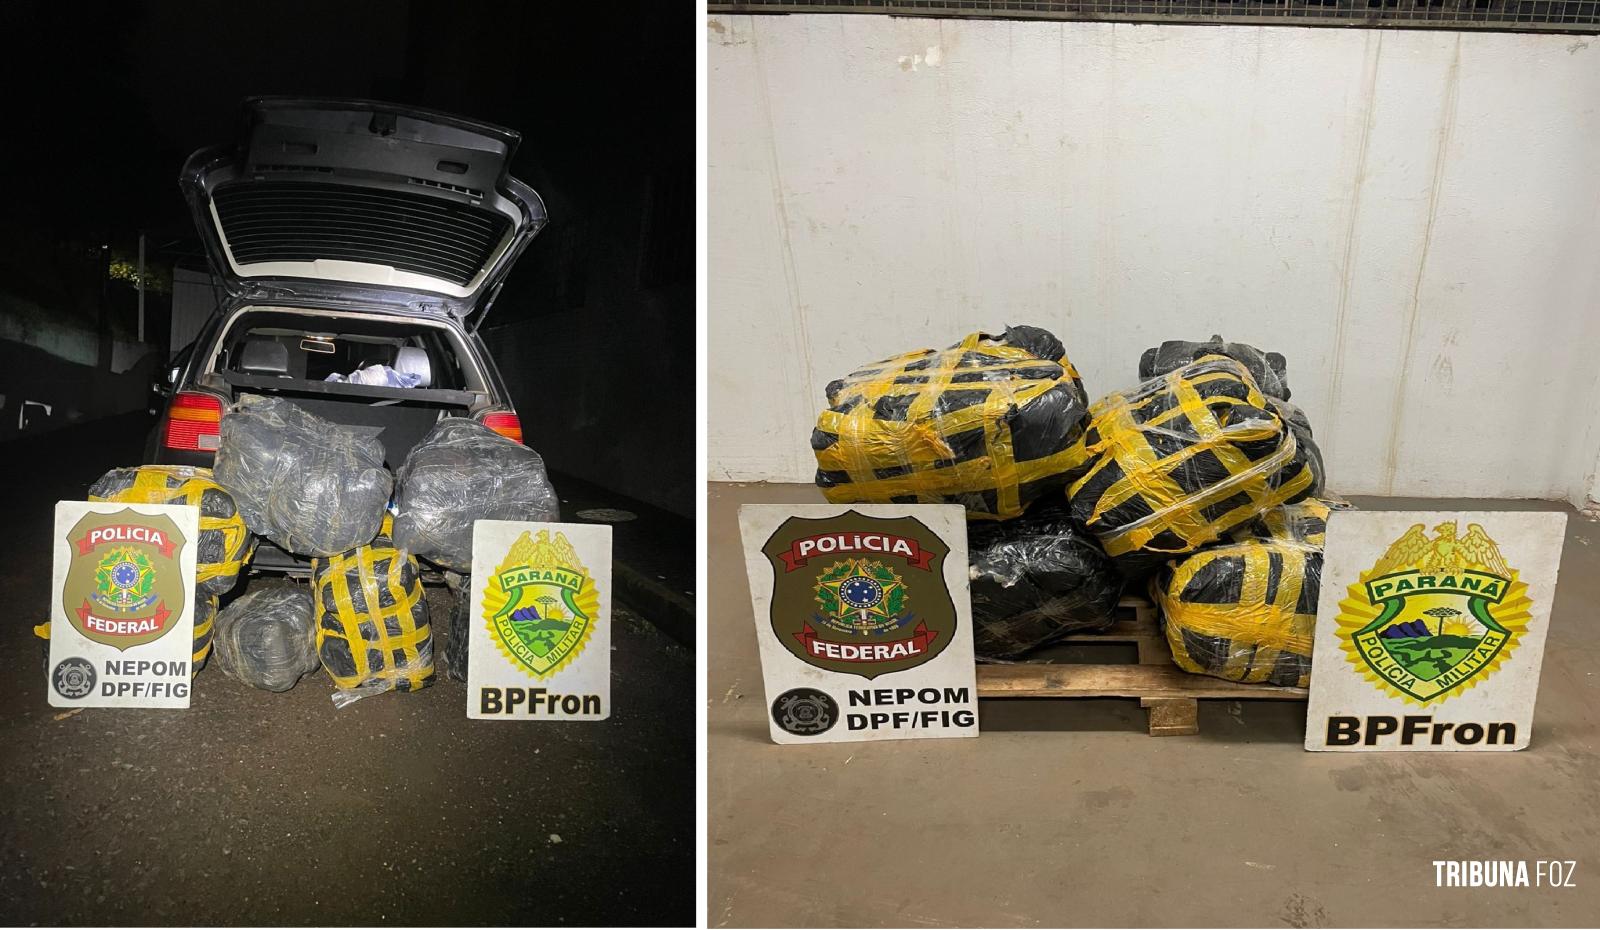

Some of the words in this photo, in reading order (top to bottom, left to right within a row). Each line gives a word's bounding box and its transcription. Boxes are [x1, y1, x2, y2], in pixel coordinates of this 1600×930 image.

[504, 571, 579, 589] PARANÁ
[1375, 575, 1499, 598] PARANÁ
[87, 615, 159, 634] FEDERAL
[547, 620, 584, 664] MILITAR
[812, 640, 922, 660] FEDERAL
[105, 660, 187, 677] NEPOM
[1436, 635, 1502, 689] MILITAR
[101, 682, 188, 698] DPF/FIG
[848, 687, 969, 707] NEPOM
[480, 687, 602, 716] BPFron
[846, 710, 976, 731] DPF/FIG
[1326, 715, 1516, 747] BPFron
